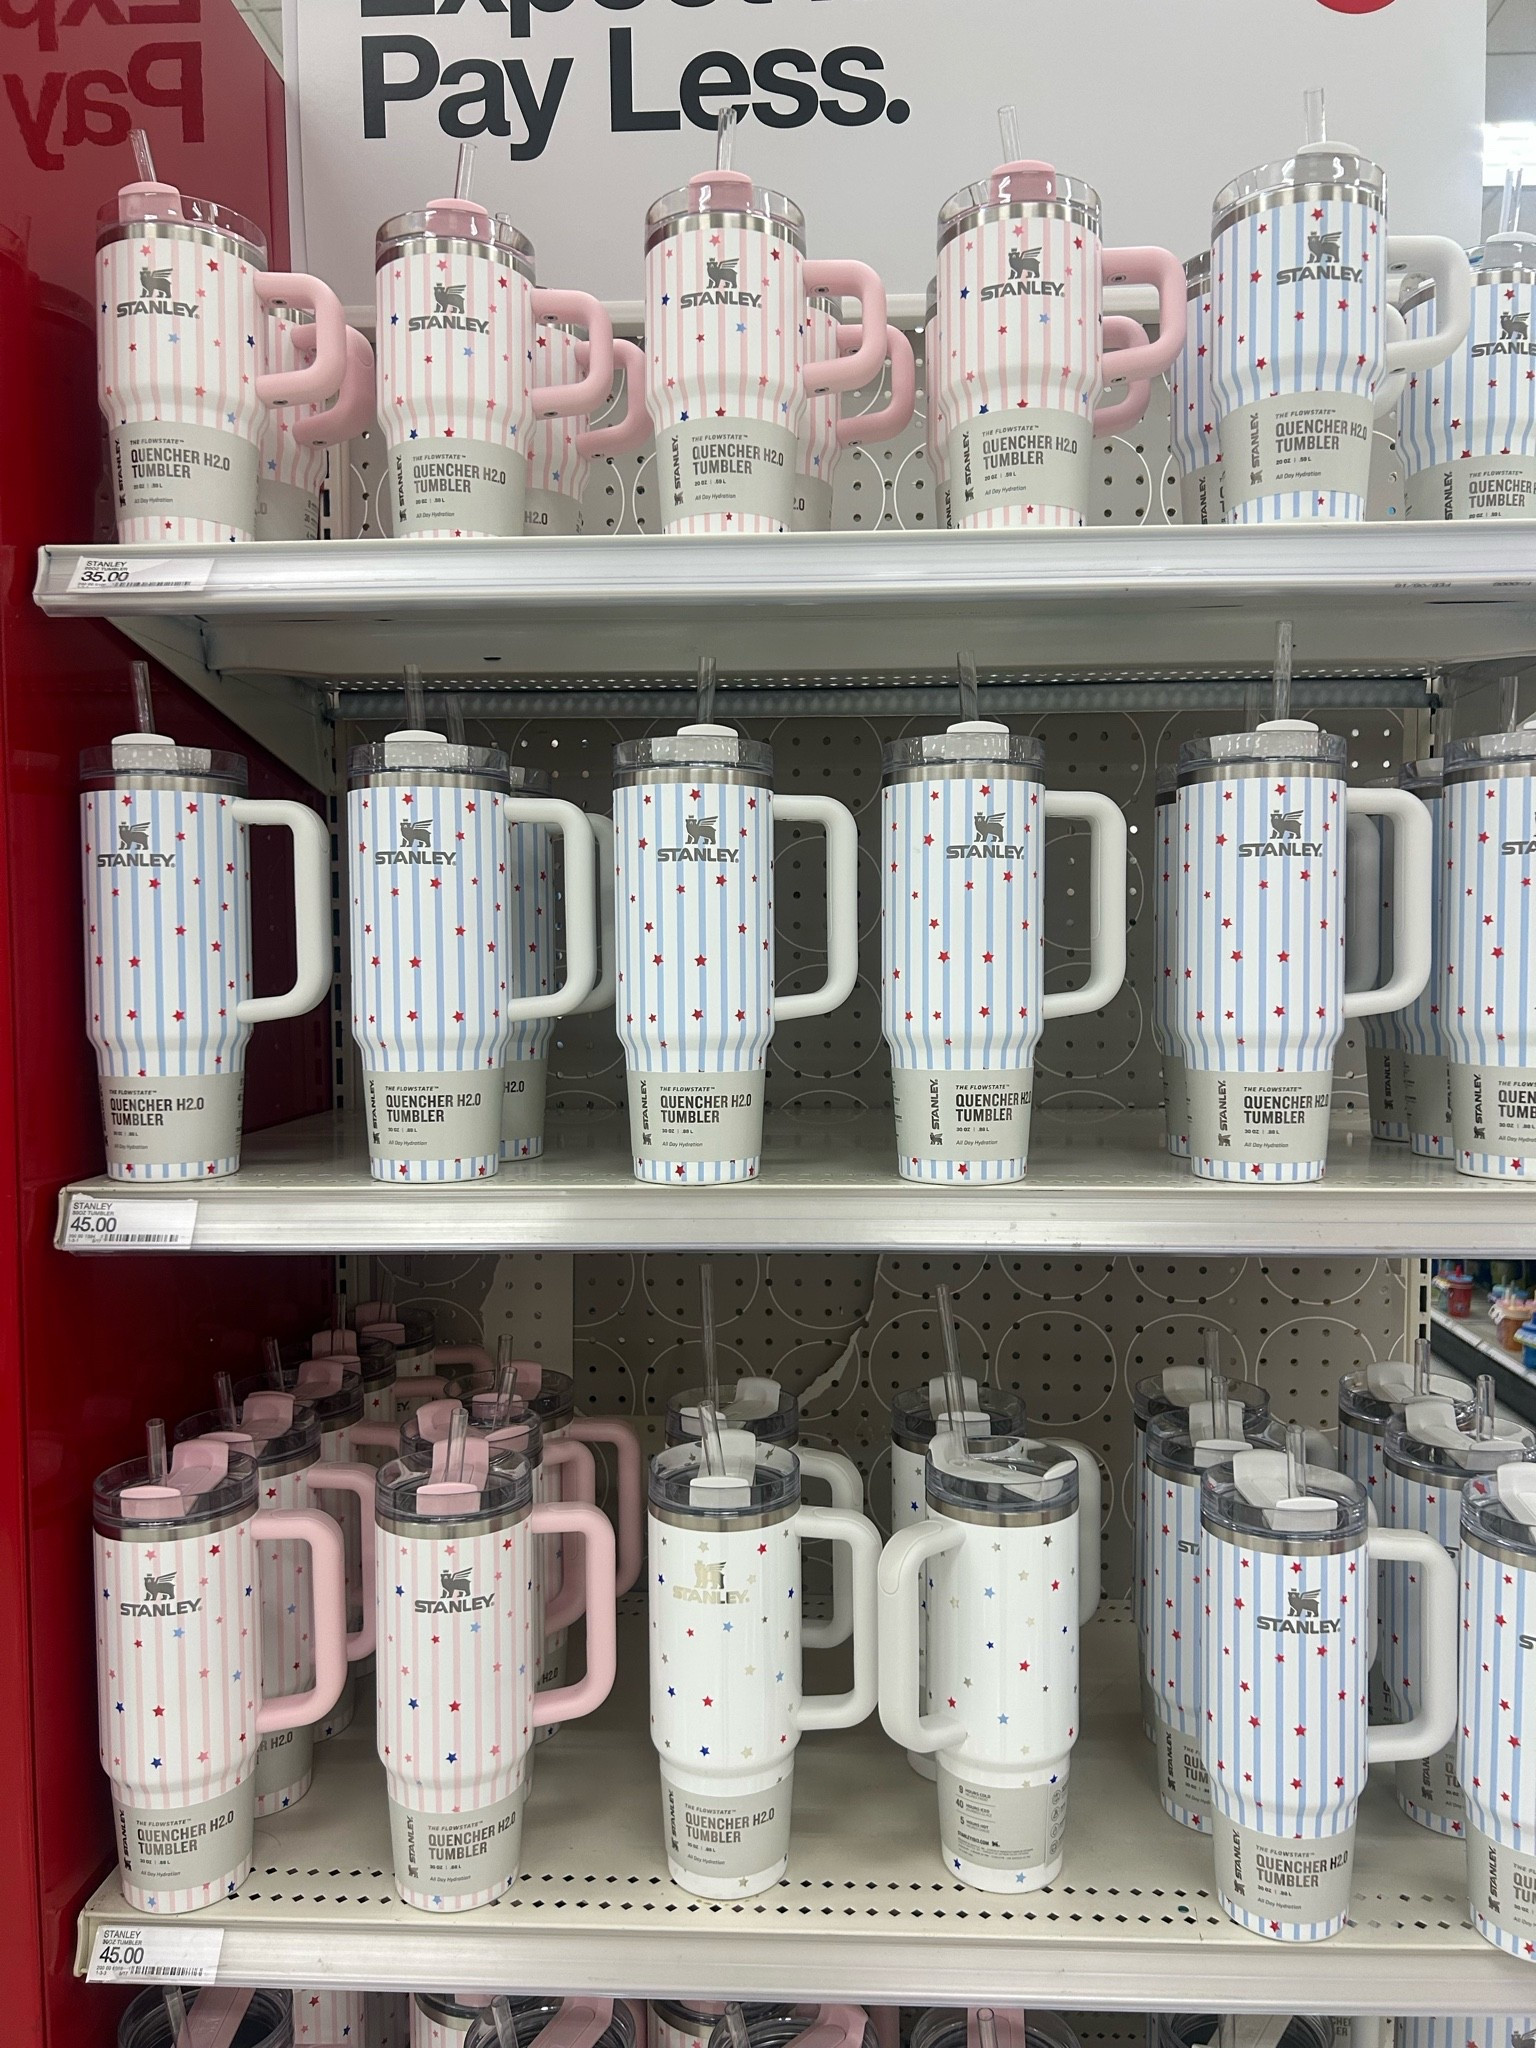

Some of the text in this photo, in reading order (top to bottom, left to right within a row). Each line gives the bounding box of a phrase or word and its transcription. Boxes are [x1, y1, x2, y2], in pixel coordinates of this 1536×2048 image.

[362, 26, 910, 161] Pay Less.
[1471, 342, 1536, 358] STANLE
[1276, 419, 1367, 440] QUENCHER H2.0
[983, 435, 1077, 454] QUENCHER H2.0
[1276, 435, 1339, 453] TUMBLER
[131, 447, 230, 471] QUENCHER H2.0
[692, 443, 783, 467] QUENCHER H2.0
[983, 452, 1044, 470] TUMBLER
[132, 464, 191, 479] TUMBLER
[414, 463, 506, 484] QUENCHER H2.0
[693, 460, 752, 475] TUMBLER
[414, 479, 471, 493] TUMBLER
[1469, 480, 1531, 495] QUENCHER
[1469, 494, 1525, 509] TUMBLER
[81, 572, 129, 582] 35.00
[110, 1097, 204, 1111] QUENCHER H2.0
[386, 1093, 481, 1108] QUENCHER H2.0
[661, 1094, 751, 1108] QUENCHER H2.0
[956, 1093, 1018, 1107] QUENCHER
[1244, 1094, 1329, 1109] QUENCHER H2.0
[111, 1112, 163, 1125] TUMBLER
[387, 1109, 444, 1122] TUMBLER
[661, 1110, 719, 1123] TUMBLER
[956, 1108, 1012, 1121] TUMBLER
[1244, 1110, 1304, 1124] TUMBLER
[73, 1202, 112, 1210] STANLEY
[71, 1217, 117, 1232] 45.00
[271, 1732, 293, 1749] H2.0
[686, 1808, 775, 1830] QUENCHER H2.0
[137, 1811, 234, 1843] QUENCHER H2.0
[429, 1811, 516, 1847] QUENCHER H2.0
[686, 1825, 741, 1843] TUMBLER
[138, 1839, 198, 1855] TUMBLER
[429, 1842, 487, 1861] TUMBLER
[1256, 1851, 1348, 1874] QUENCHER H2.0
[1257, 1867, 1318, 1887] TUMBLER
[104, 1930, 141, 1939] STANLEY
[100, 1946, 144, 1964] 45.00
